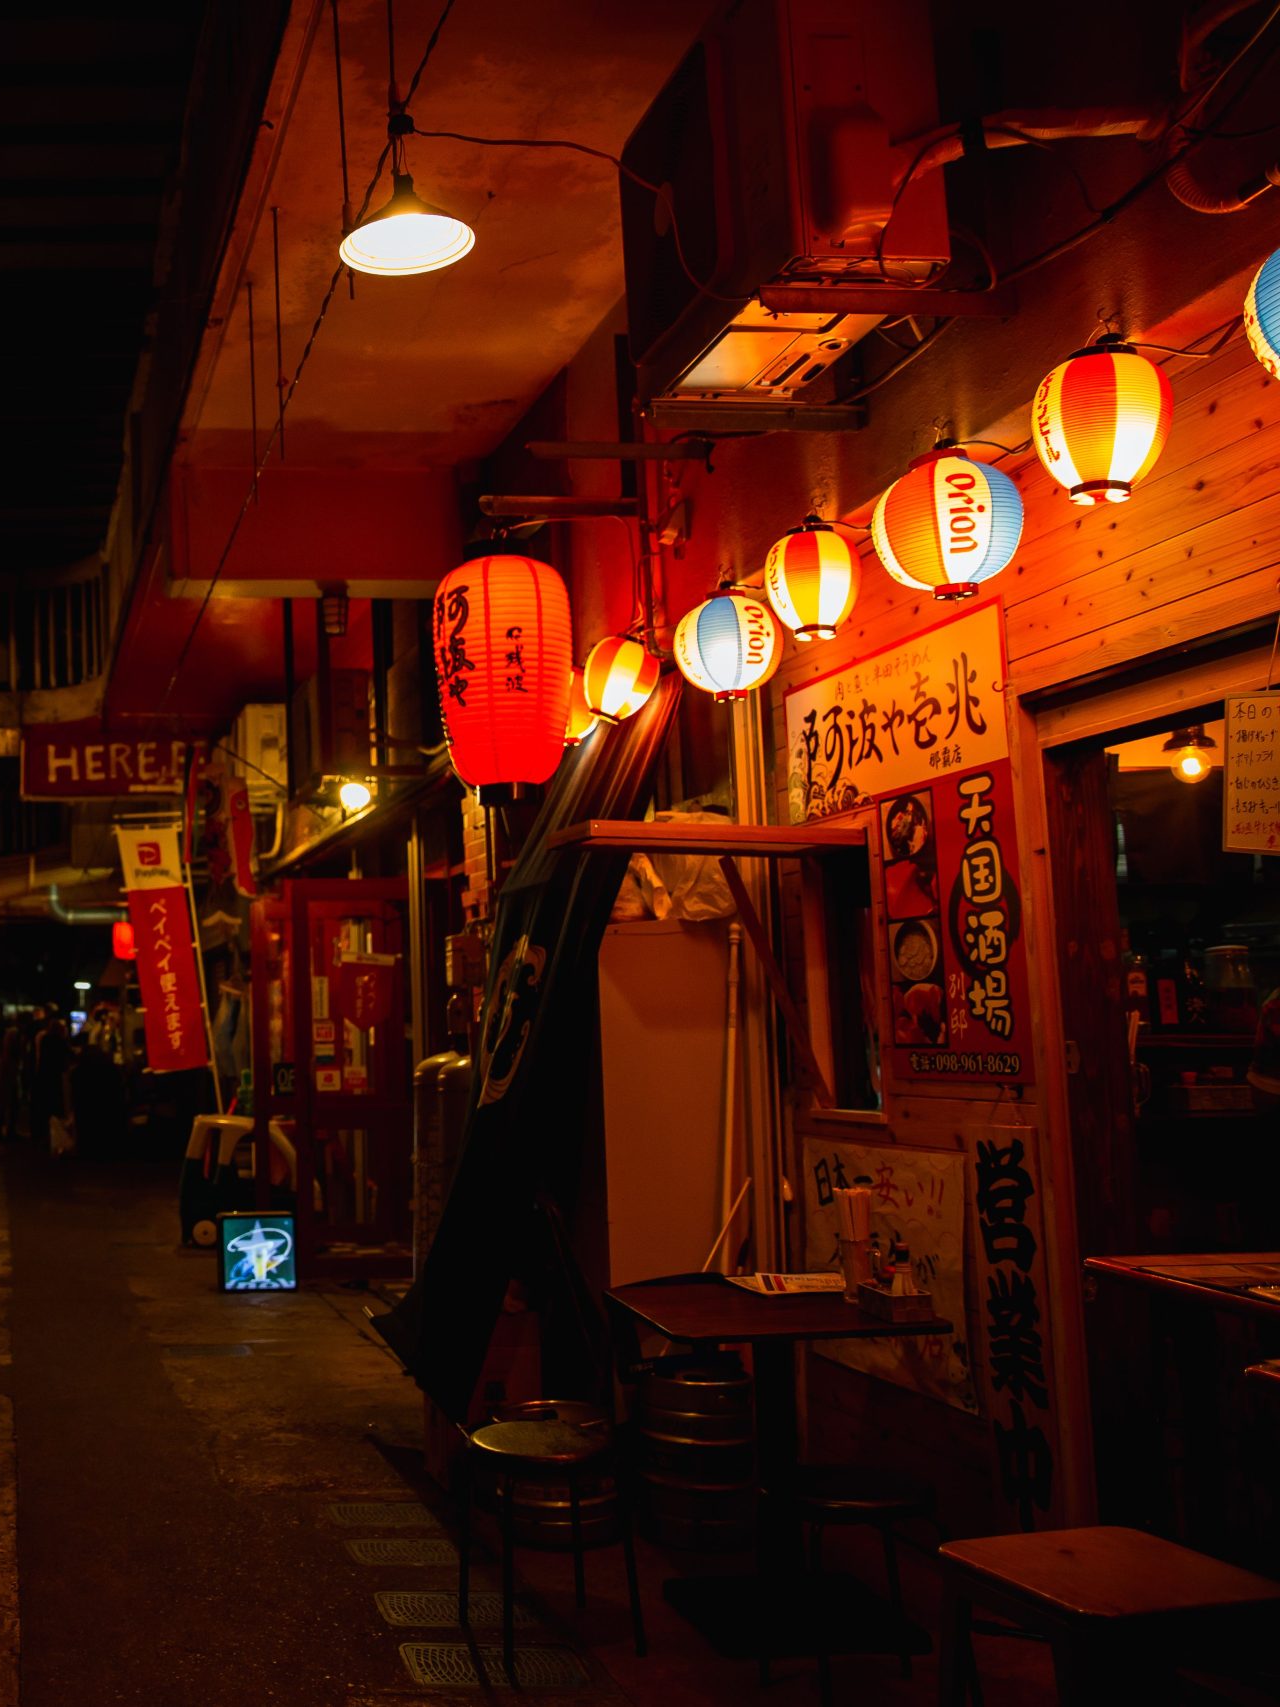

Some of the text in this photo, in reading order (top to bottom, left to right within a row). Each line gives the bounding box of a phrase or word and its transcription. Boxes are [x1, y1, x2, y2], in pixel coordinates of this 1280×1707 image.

[945, 472, 985, 554] Orion
[744, 605, 771, 665] Orion
[1232, 702, 1280, 721] 本日の
[929, 744, 963, 770] 那覇店
[958, 774, 1013, 1039] 天国酒場
[976, 1138, 1054, 1531] 営業中
